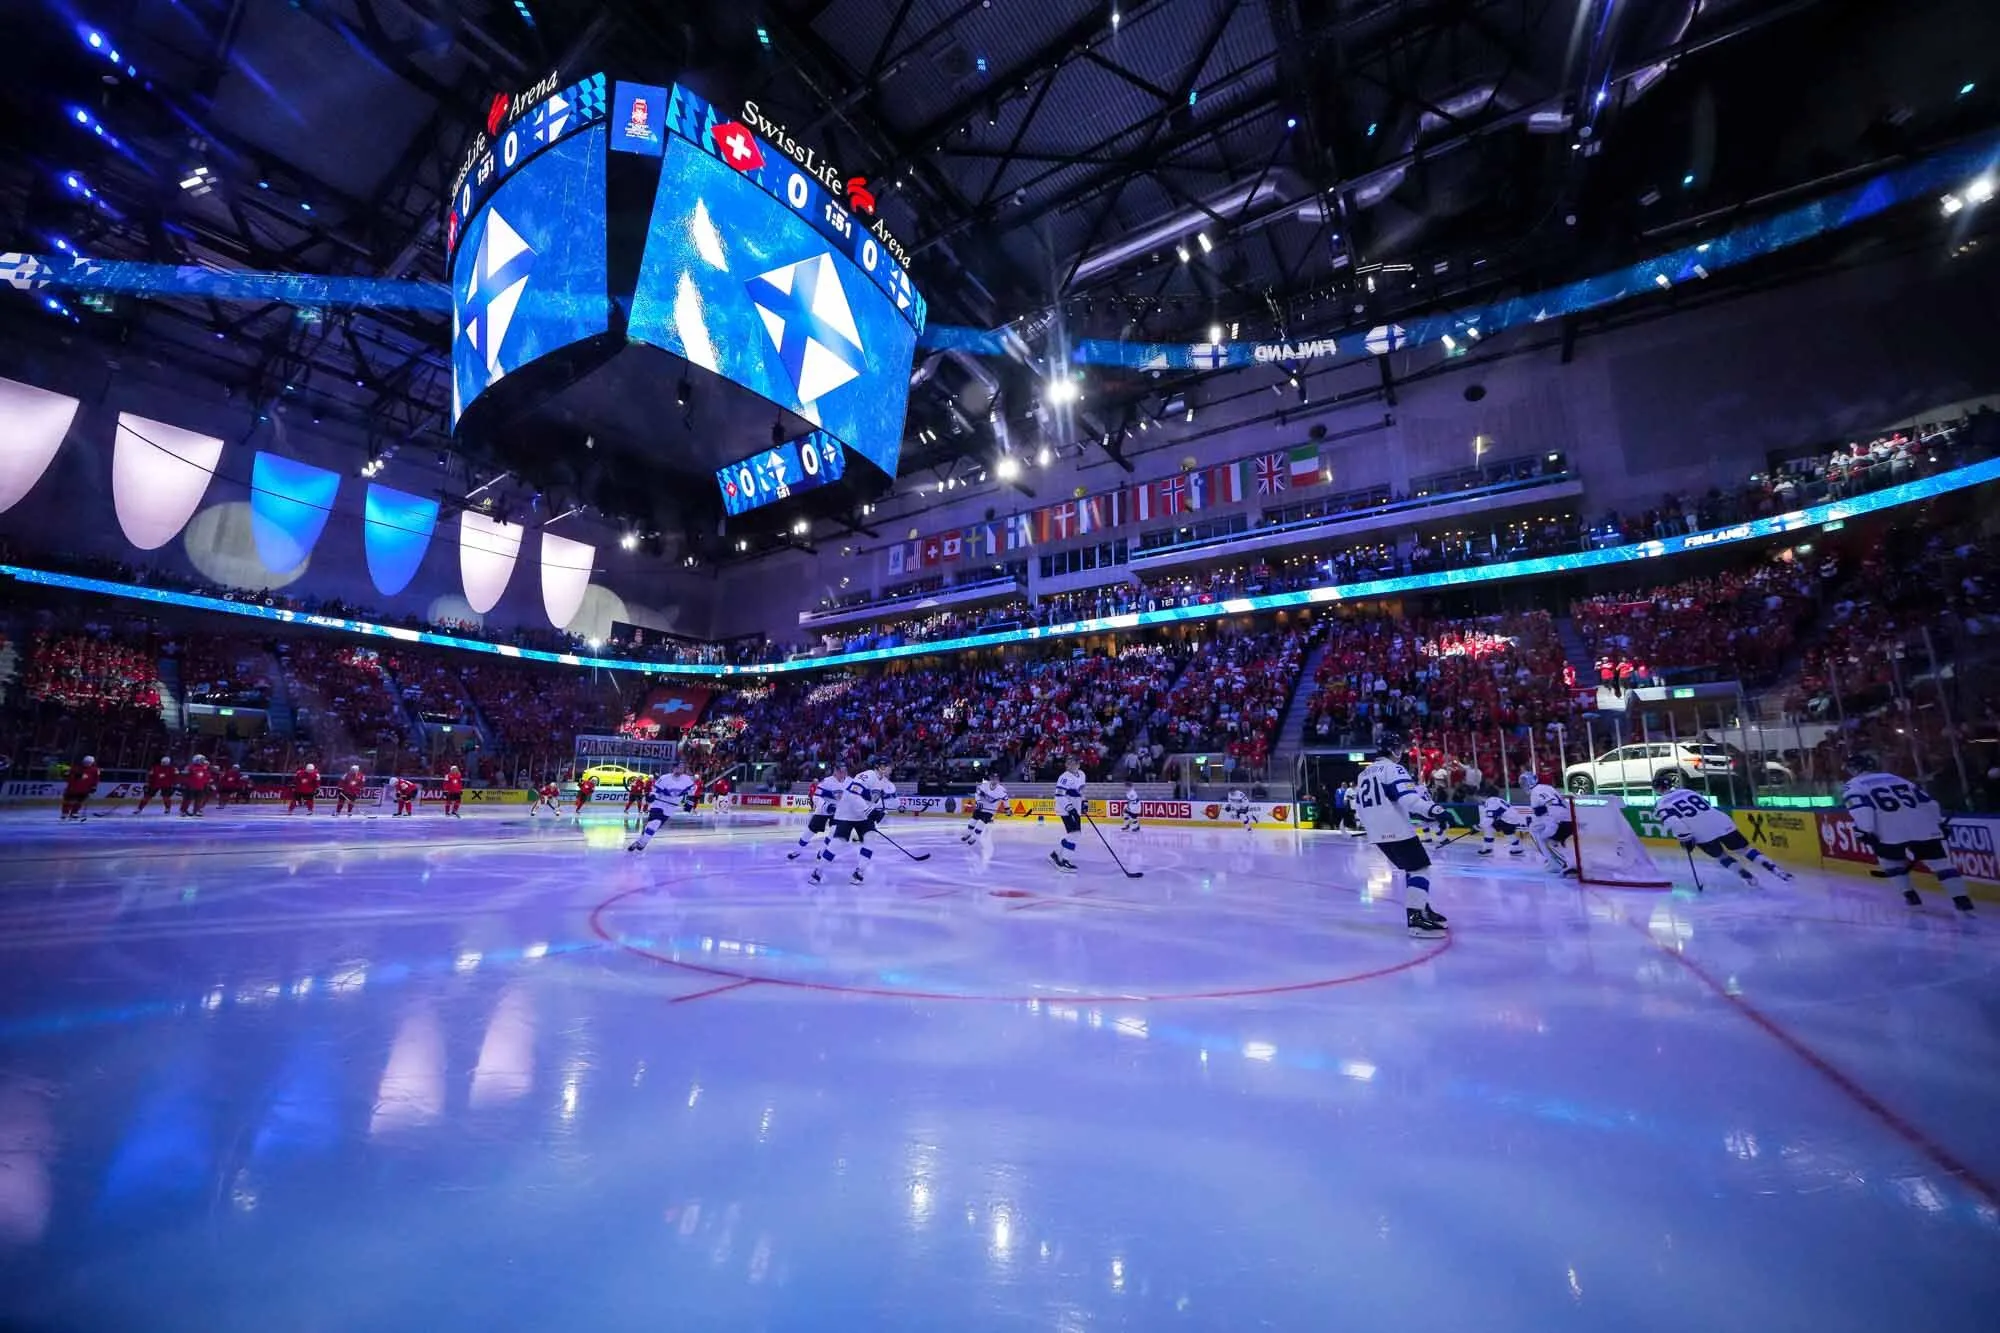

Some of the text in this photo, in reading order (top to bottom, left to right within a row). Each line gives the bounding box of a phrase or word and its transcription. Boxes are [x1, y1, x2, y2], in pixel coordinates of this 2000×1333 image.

[508, 70, 559, 121] Arena
[504, 131, 518, 167] 0
[742, 100, 912, 269] SwissLife Arena
[787, 173, 808, 209] 0
[825, 204, 852, 239] 1:51
[863, 239, 878, 271] 0
[740, 443, 819, 497] 0 0
[907, 798, 941, 807] TISSOT
[1111, 803, 1190, 816] BHAUS
[1360, 775, 1382, 809] 21
[1674, 795, 1710, 818] 58
[1870, 784, 1917, 812] 65
